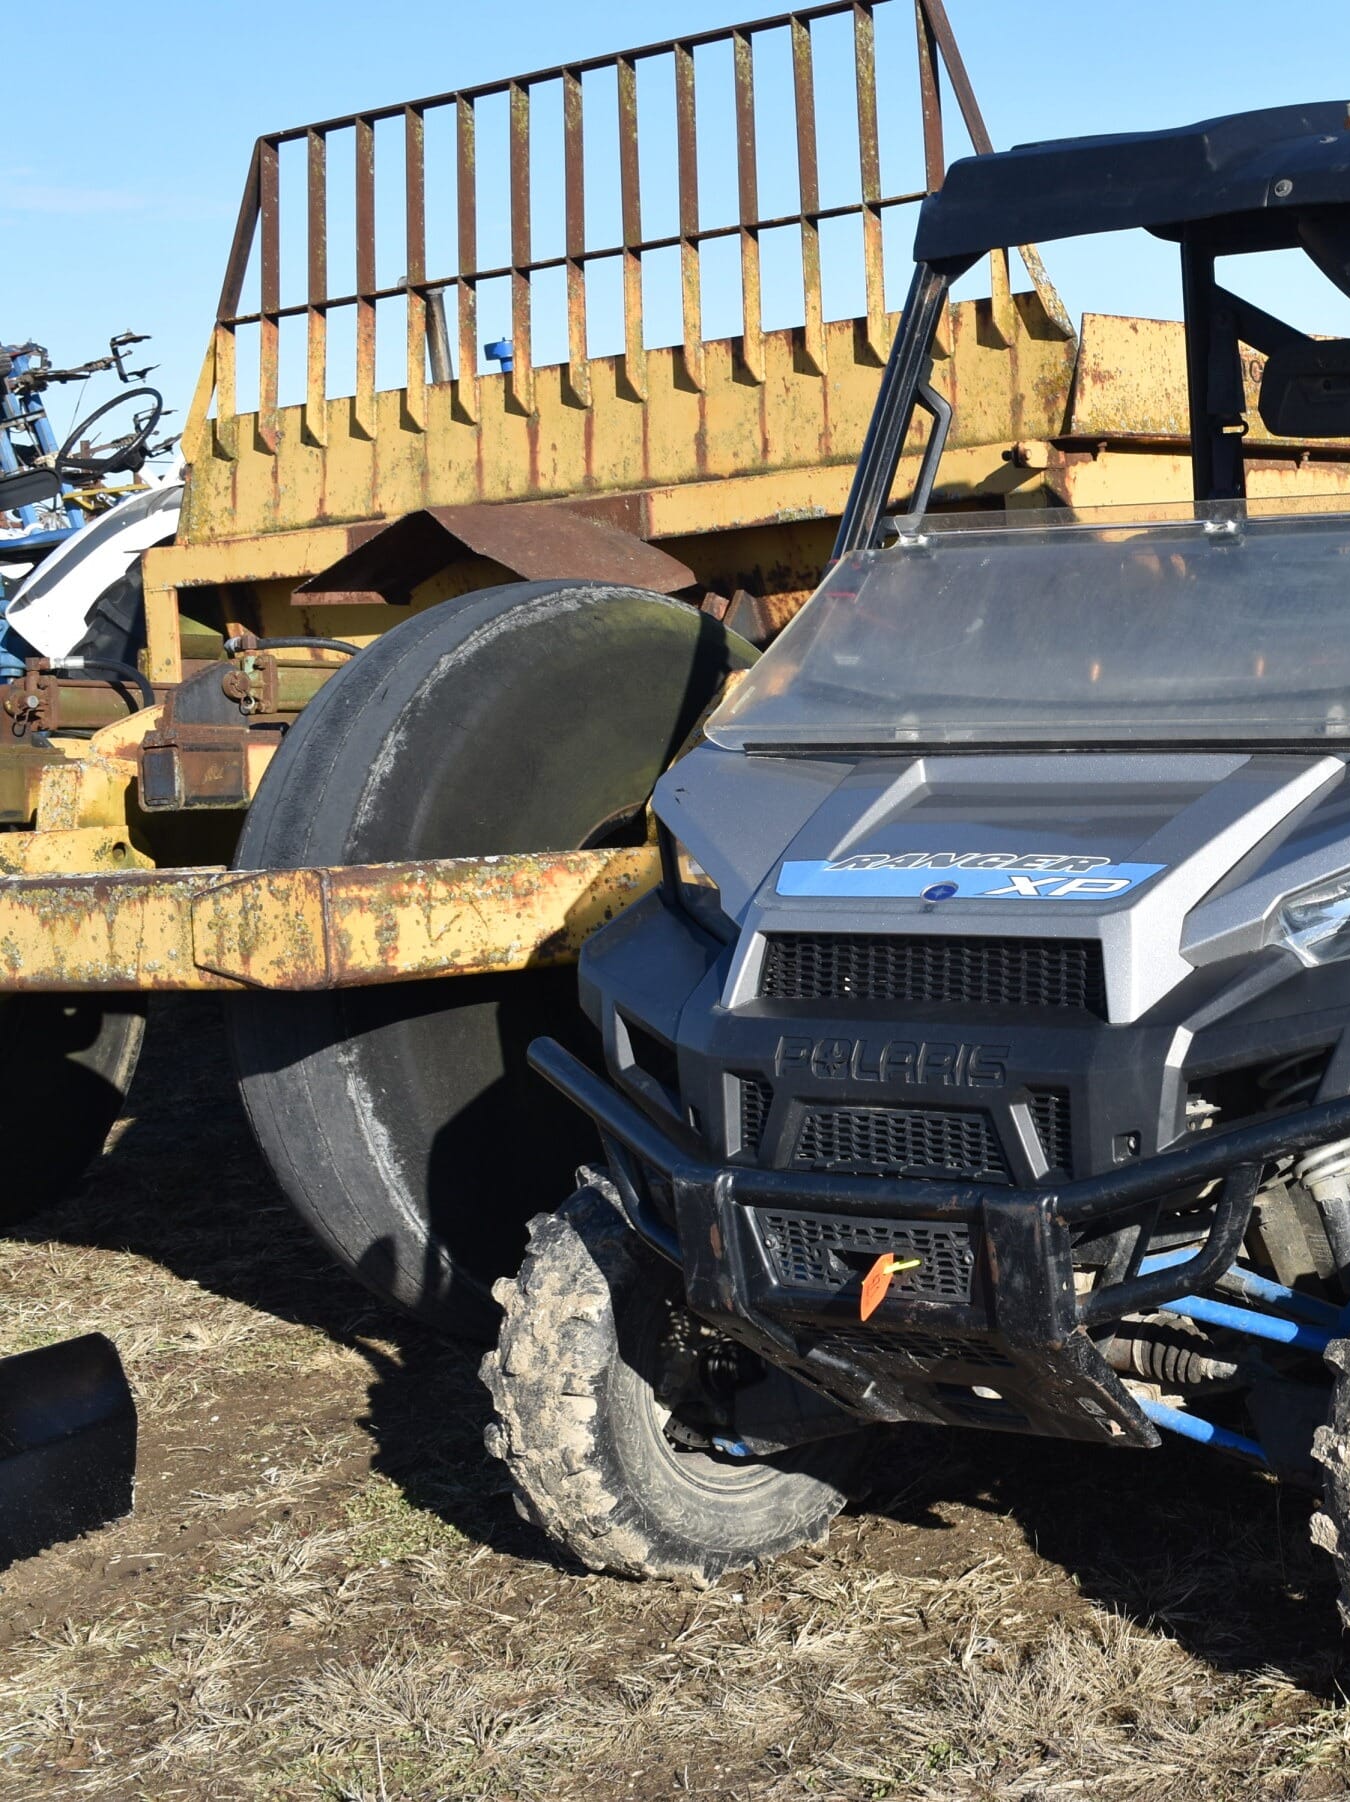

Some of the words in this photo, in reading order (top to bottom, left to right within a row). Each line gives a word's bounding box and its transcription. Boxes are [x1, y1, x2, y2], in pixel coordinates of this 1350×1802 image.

[825, 853, 1111, 873] RANGER
[974, 876, 1131, 897] XP
[774, 1035, 1011, 1088] POLARIS
